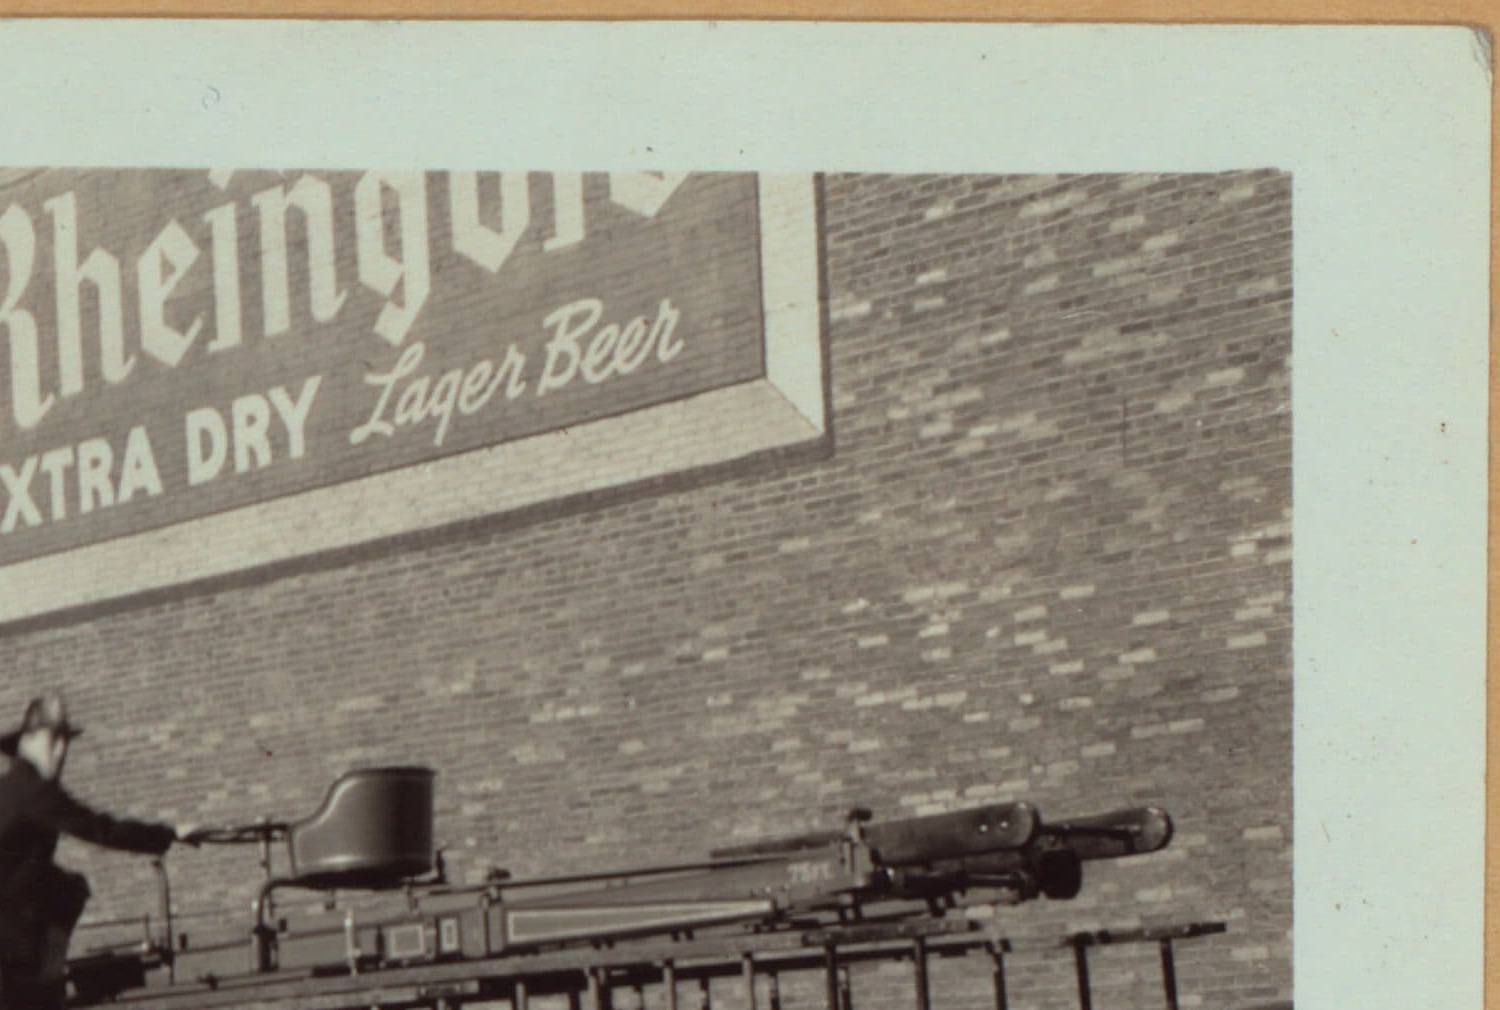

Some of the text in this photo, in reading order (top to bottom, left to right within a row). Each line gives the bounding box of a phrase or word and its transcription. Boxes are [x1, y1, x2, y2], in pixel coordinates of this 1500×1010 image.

[186, 375, 322, 486] DRY
[350, 341, 527, 446] Lager
[537, 298, 685, 396] Beer
